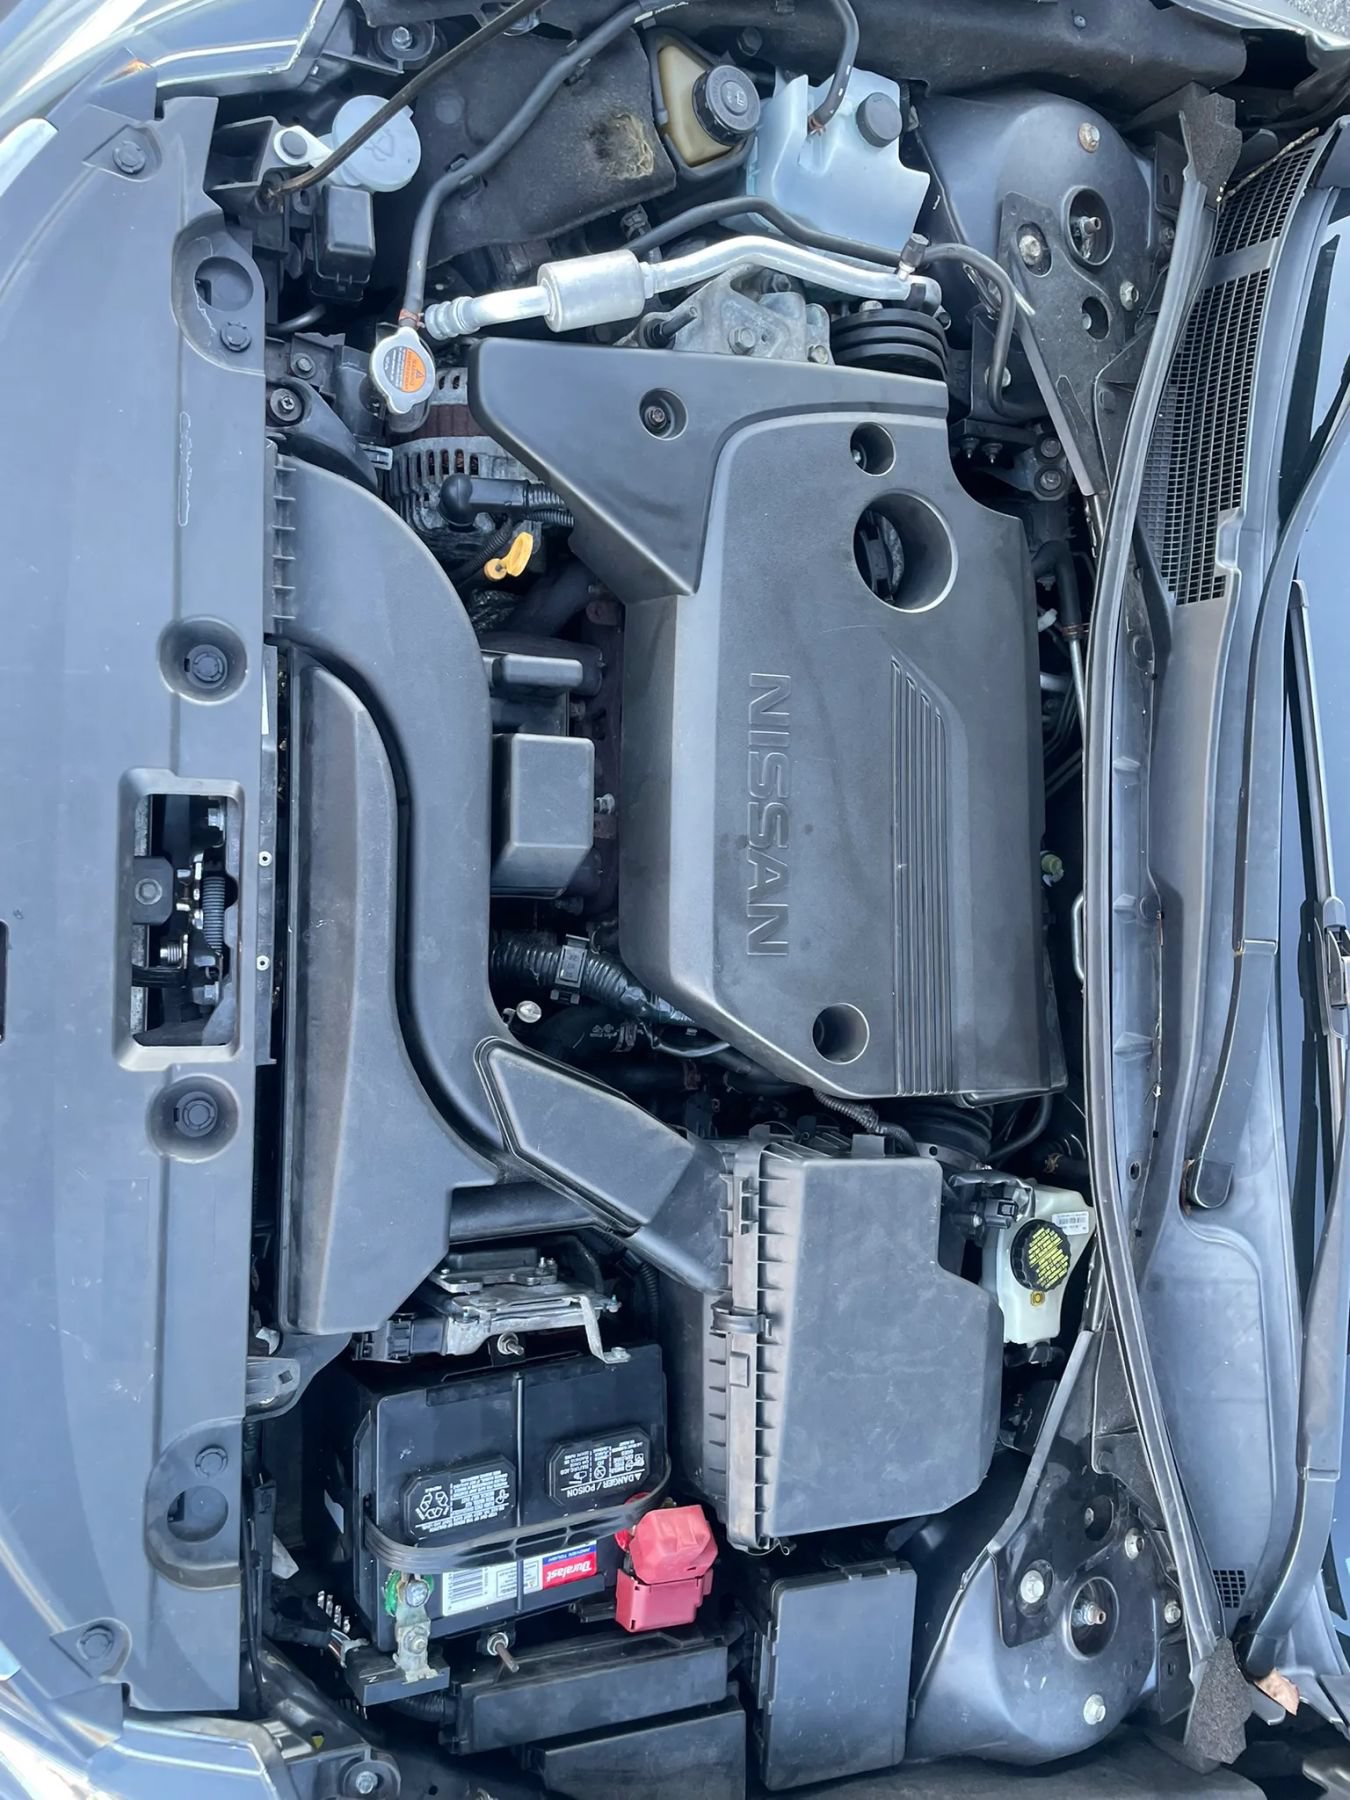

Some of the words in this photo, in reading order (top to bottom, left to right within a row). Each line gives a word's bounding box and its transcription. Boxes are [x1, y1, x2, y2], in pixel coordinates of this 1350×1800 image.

[748, 673, 791, 957] NISSAN
[603, 1474, 634, 1488] DANGER
[567, 1483, 595, 1498] POISON
[546, 1561, 592, 1582] Duralast
